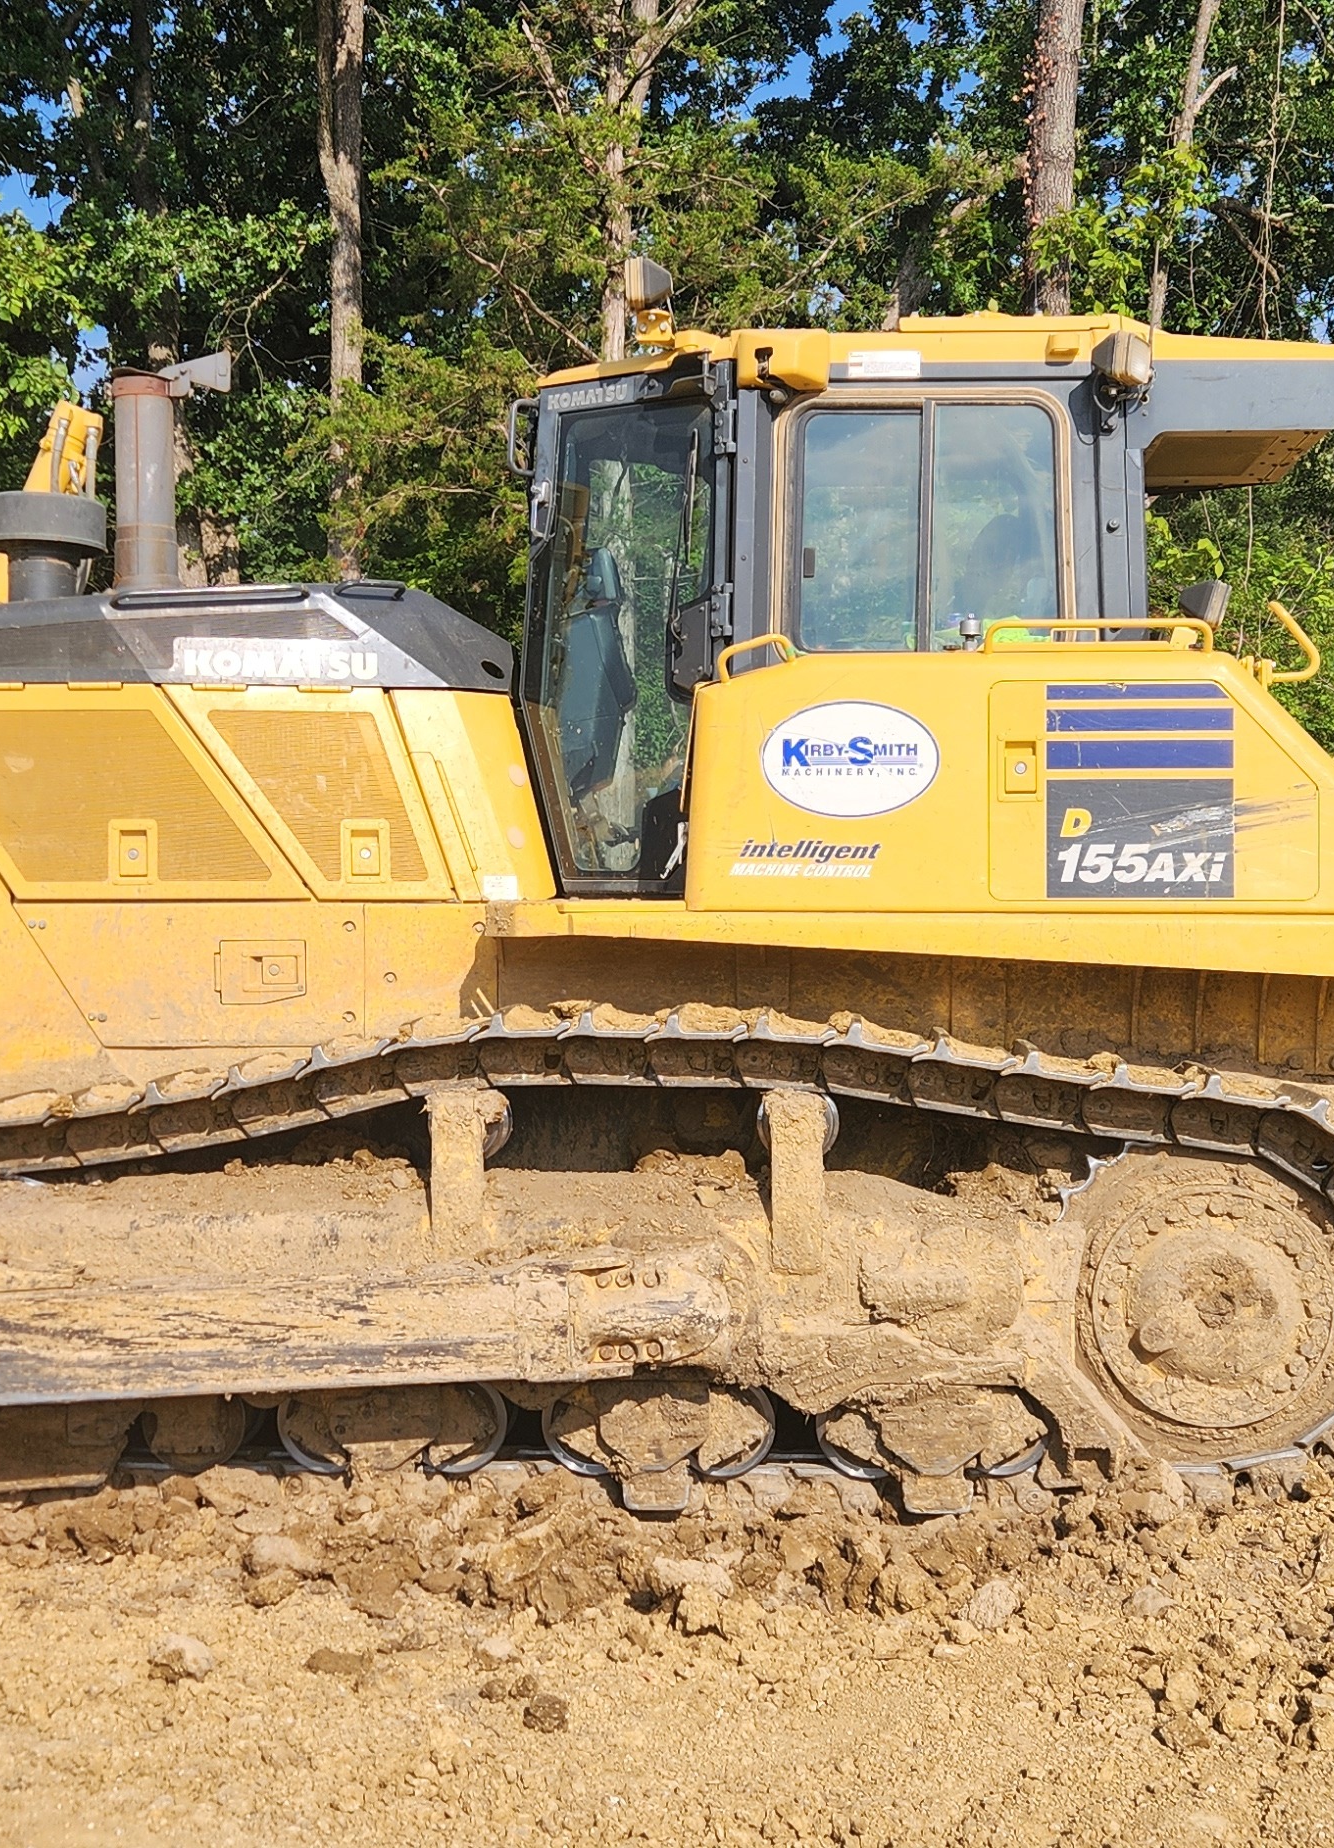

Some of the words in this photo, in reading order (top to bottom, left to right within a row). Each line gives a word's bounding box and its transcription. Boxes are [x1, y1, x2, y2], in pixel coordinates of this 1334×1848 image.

[547, 384, 627, 410] KOMATSU
[184, 649, 378, 680] KOMATSU
[783, 736, 918, 767] KIRBY-SMITH
[781, 767, 880, 777] MACHINERY,
[1060, 808, 1092, 838] D
[740, 839, 881, 864] intelligent
[1057, 843, 1227, 884] 155AXi
[729, 863, 803, 876] MACHINE
[803, 864, 873, 878] CONTROL
